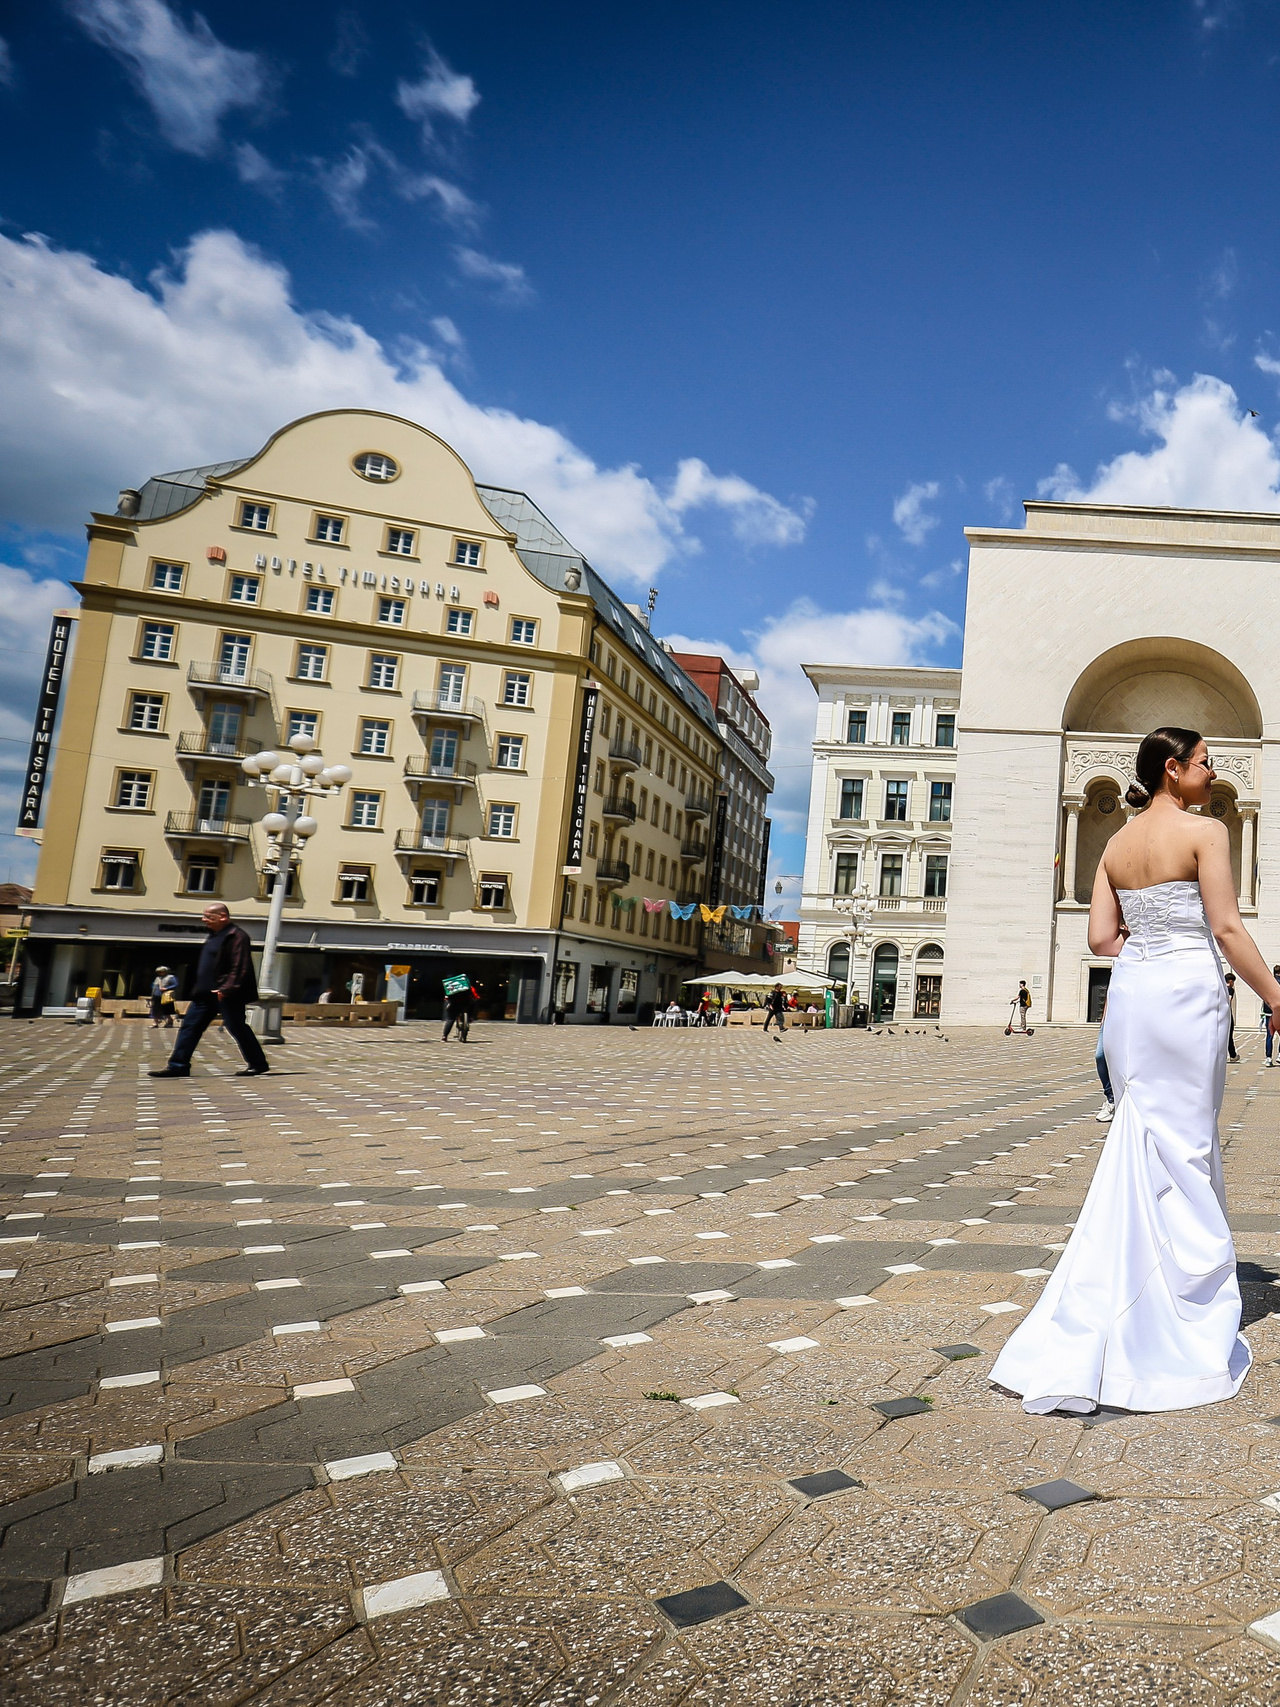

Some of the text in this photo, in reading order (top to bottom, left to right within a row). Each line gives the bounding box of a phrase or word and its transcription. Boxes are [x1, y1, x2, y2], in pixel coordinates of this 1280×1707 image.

[254, 553, 326, 579] HOTEL
[46, 625, 67, 695] HOTEL
[583, 695, 596, 753] HOTEL
[387, 942, 451, 951] STARBUCKS
